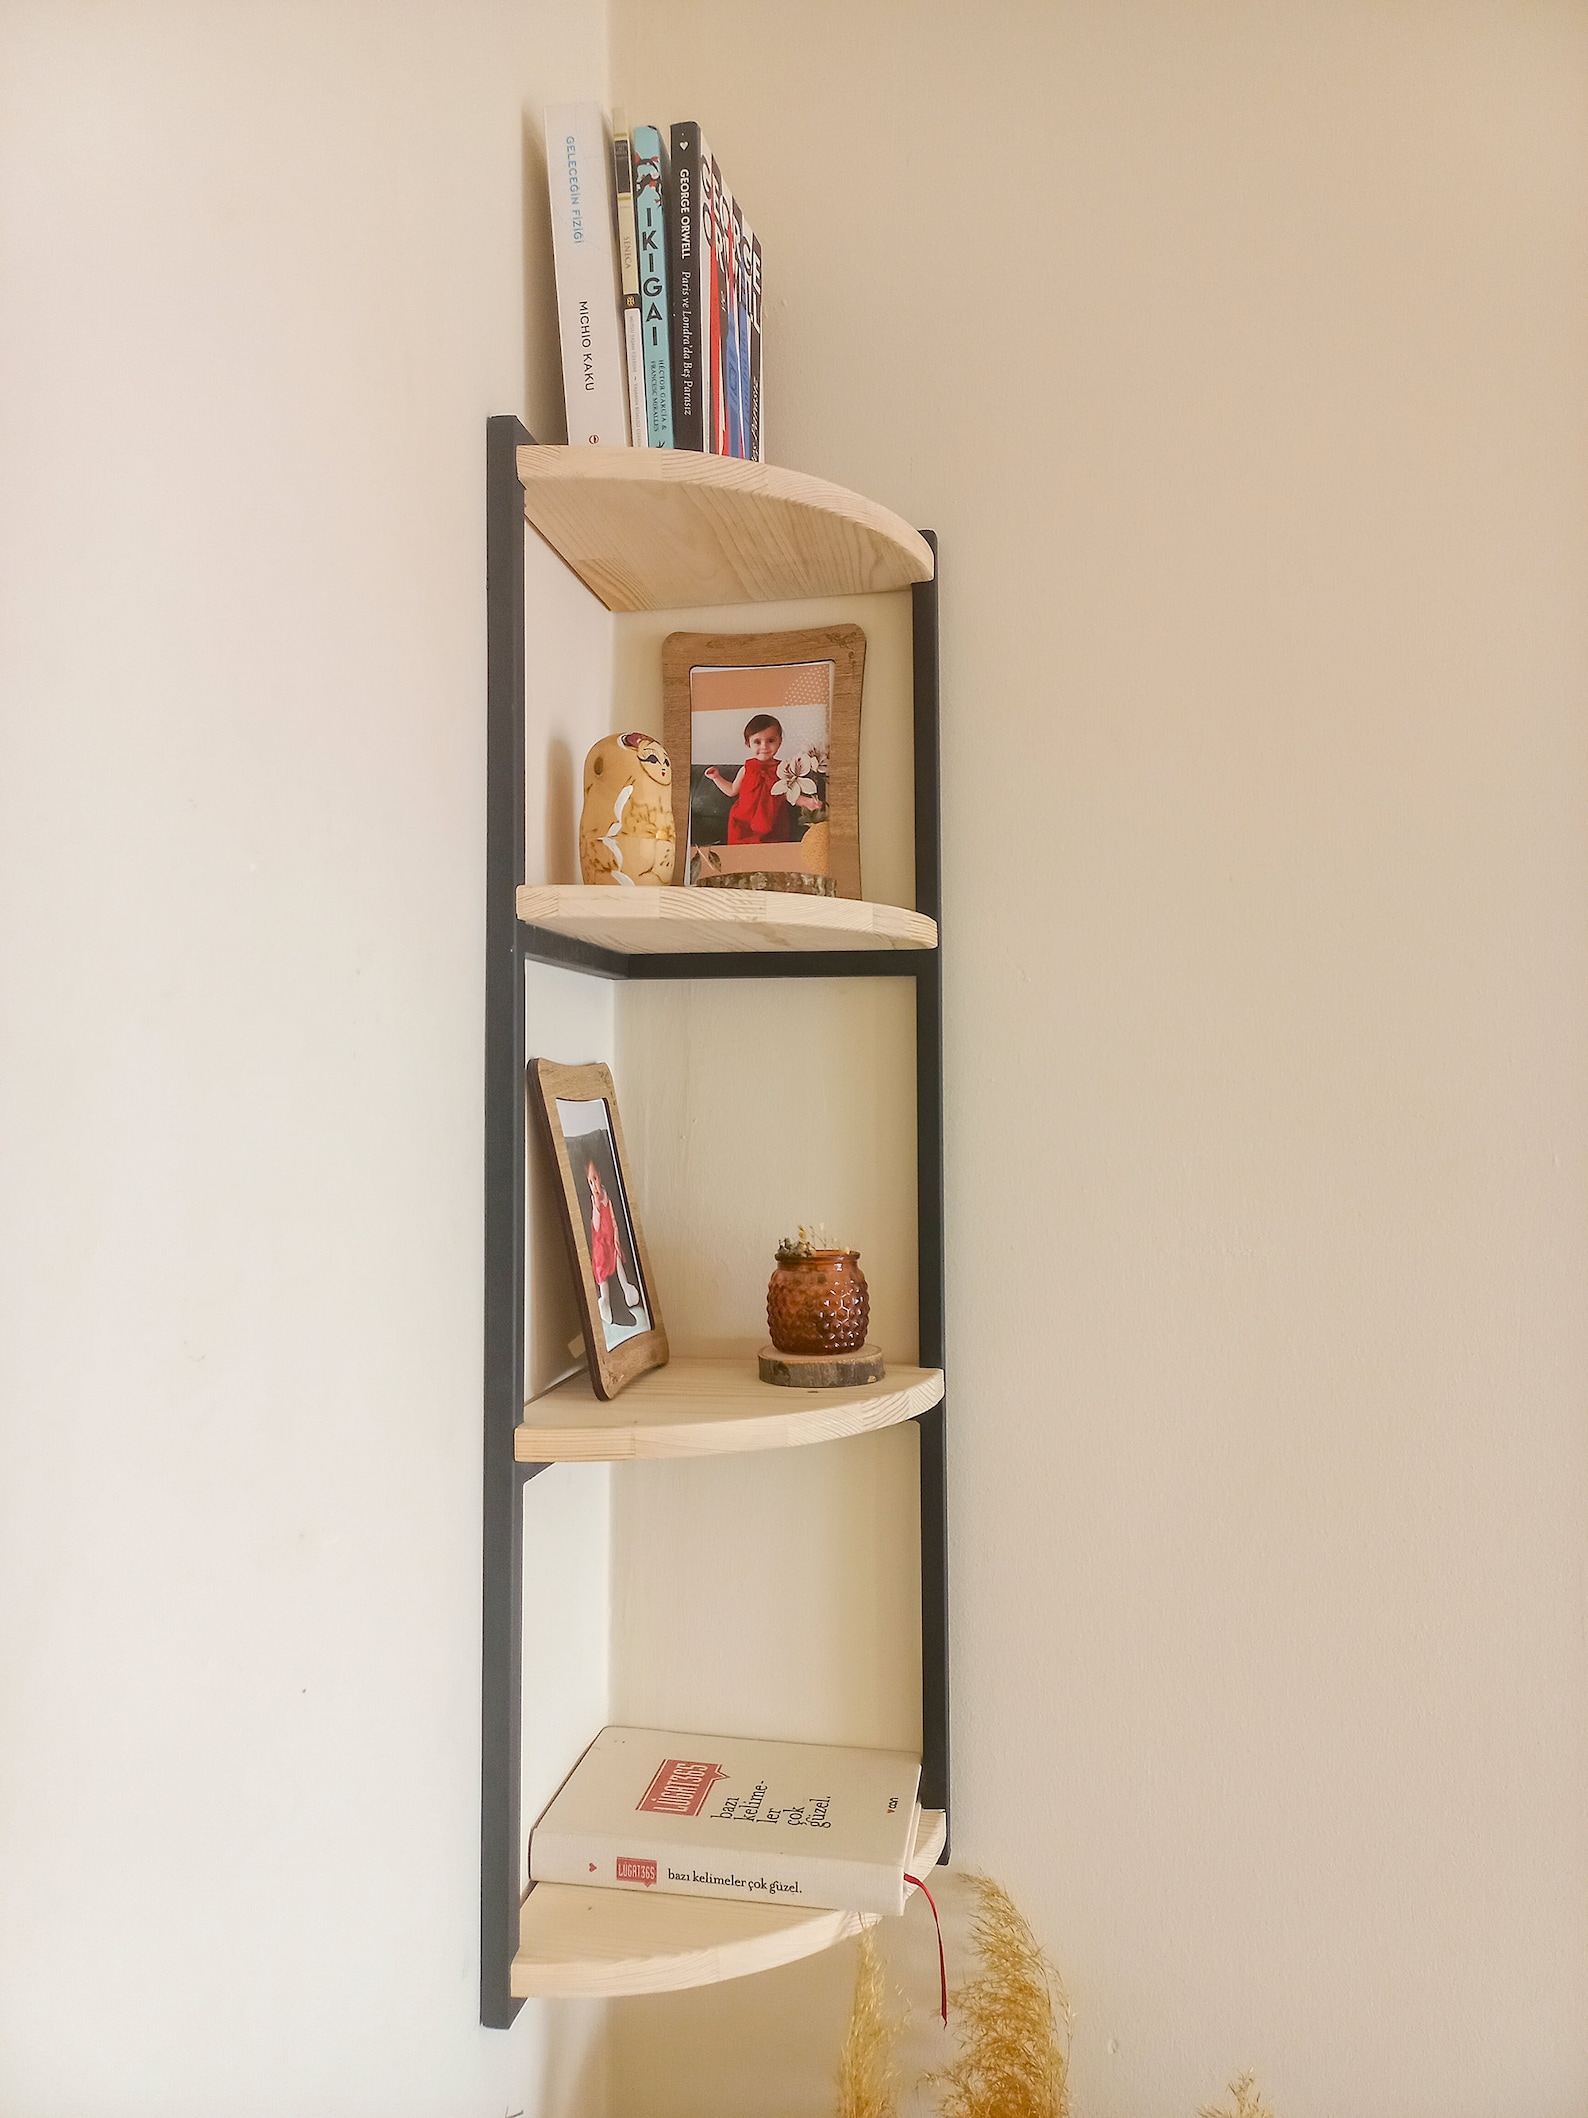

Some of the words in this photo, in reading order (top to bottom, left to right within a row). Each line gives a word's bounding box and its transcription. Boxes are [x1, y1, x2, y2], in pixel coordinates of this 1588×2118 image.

[680, 168, 690, 214] GEORGE
[681, 216, 691, 260] ORWELL
[700, 154, 761, 296] GEORGE
[623, 236, 632, 269] SENECA
[642, 207, 663, 346] IKIGAI
[681, 271, 691, 296] Paris
[682, 298, 690, 309] ve
[579, 300, 592, 348] MICHIO
[682, 311, 693, 360] Londra'da
[583, 353, 595, 391] KAKU
[650, 361, 658, 396] FRANCESC
[681, 362, 693, 378] Beş
[683, 380, 694, 416] Parasız
[710, 1797, 740, 1819] bazı
[733, 1780, 768, 1822] kelime-
[756, 1807, 782, 1824] ler
[783, 1806, 807, 1826] çok
[668, 1868, 690, 1881] bazı
[692, 1870, 747, 1887] kelimeler
[748, 1877, 768, 1892] çok
